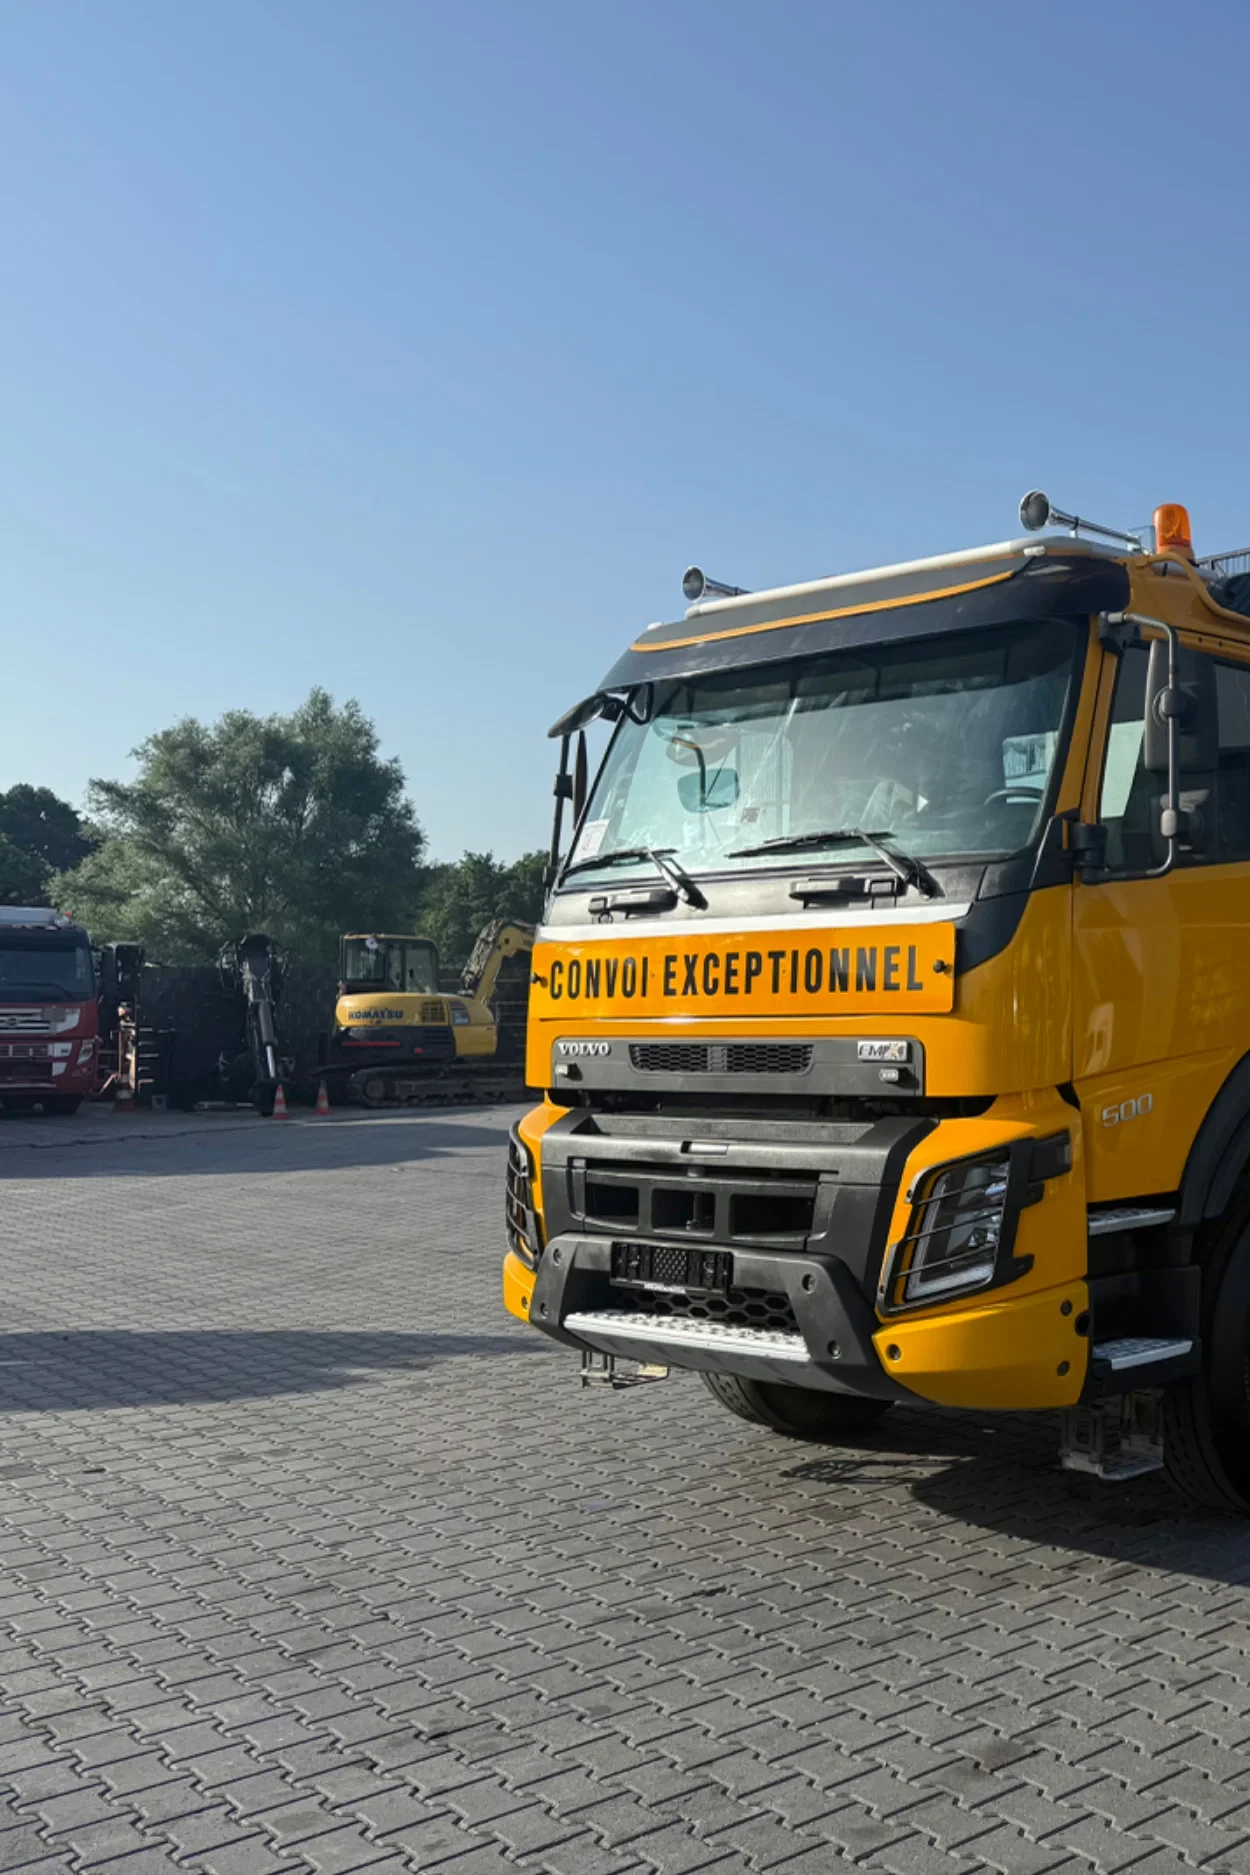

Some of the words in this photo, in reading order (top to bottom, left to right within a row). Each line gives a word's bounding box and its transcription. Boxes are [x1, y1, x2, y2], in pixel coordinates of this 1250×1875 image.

[550, 956, 649, 1000] CONVOI
[663, 945, 924, 997] EXCEPTIONNEL
[348, 1008, 404, 1020] KOMATSU
[558, 1042, 610, 1057] VOLVO
[1102, 1092, 1153, 1128] 500
